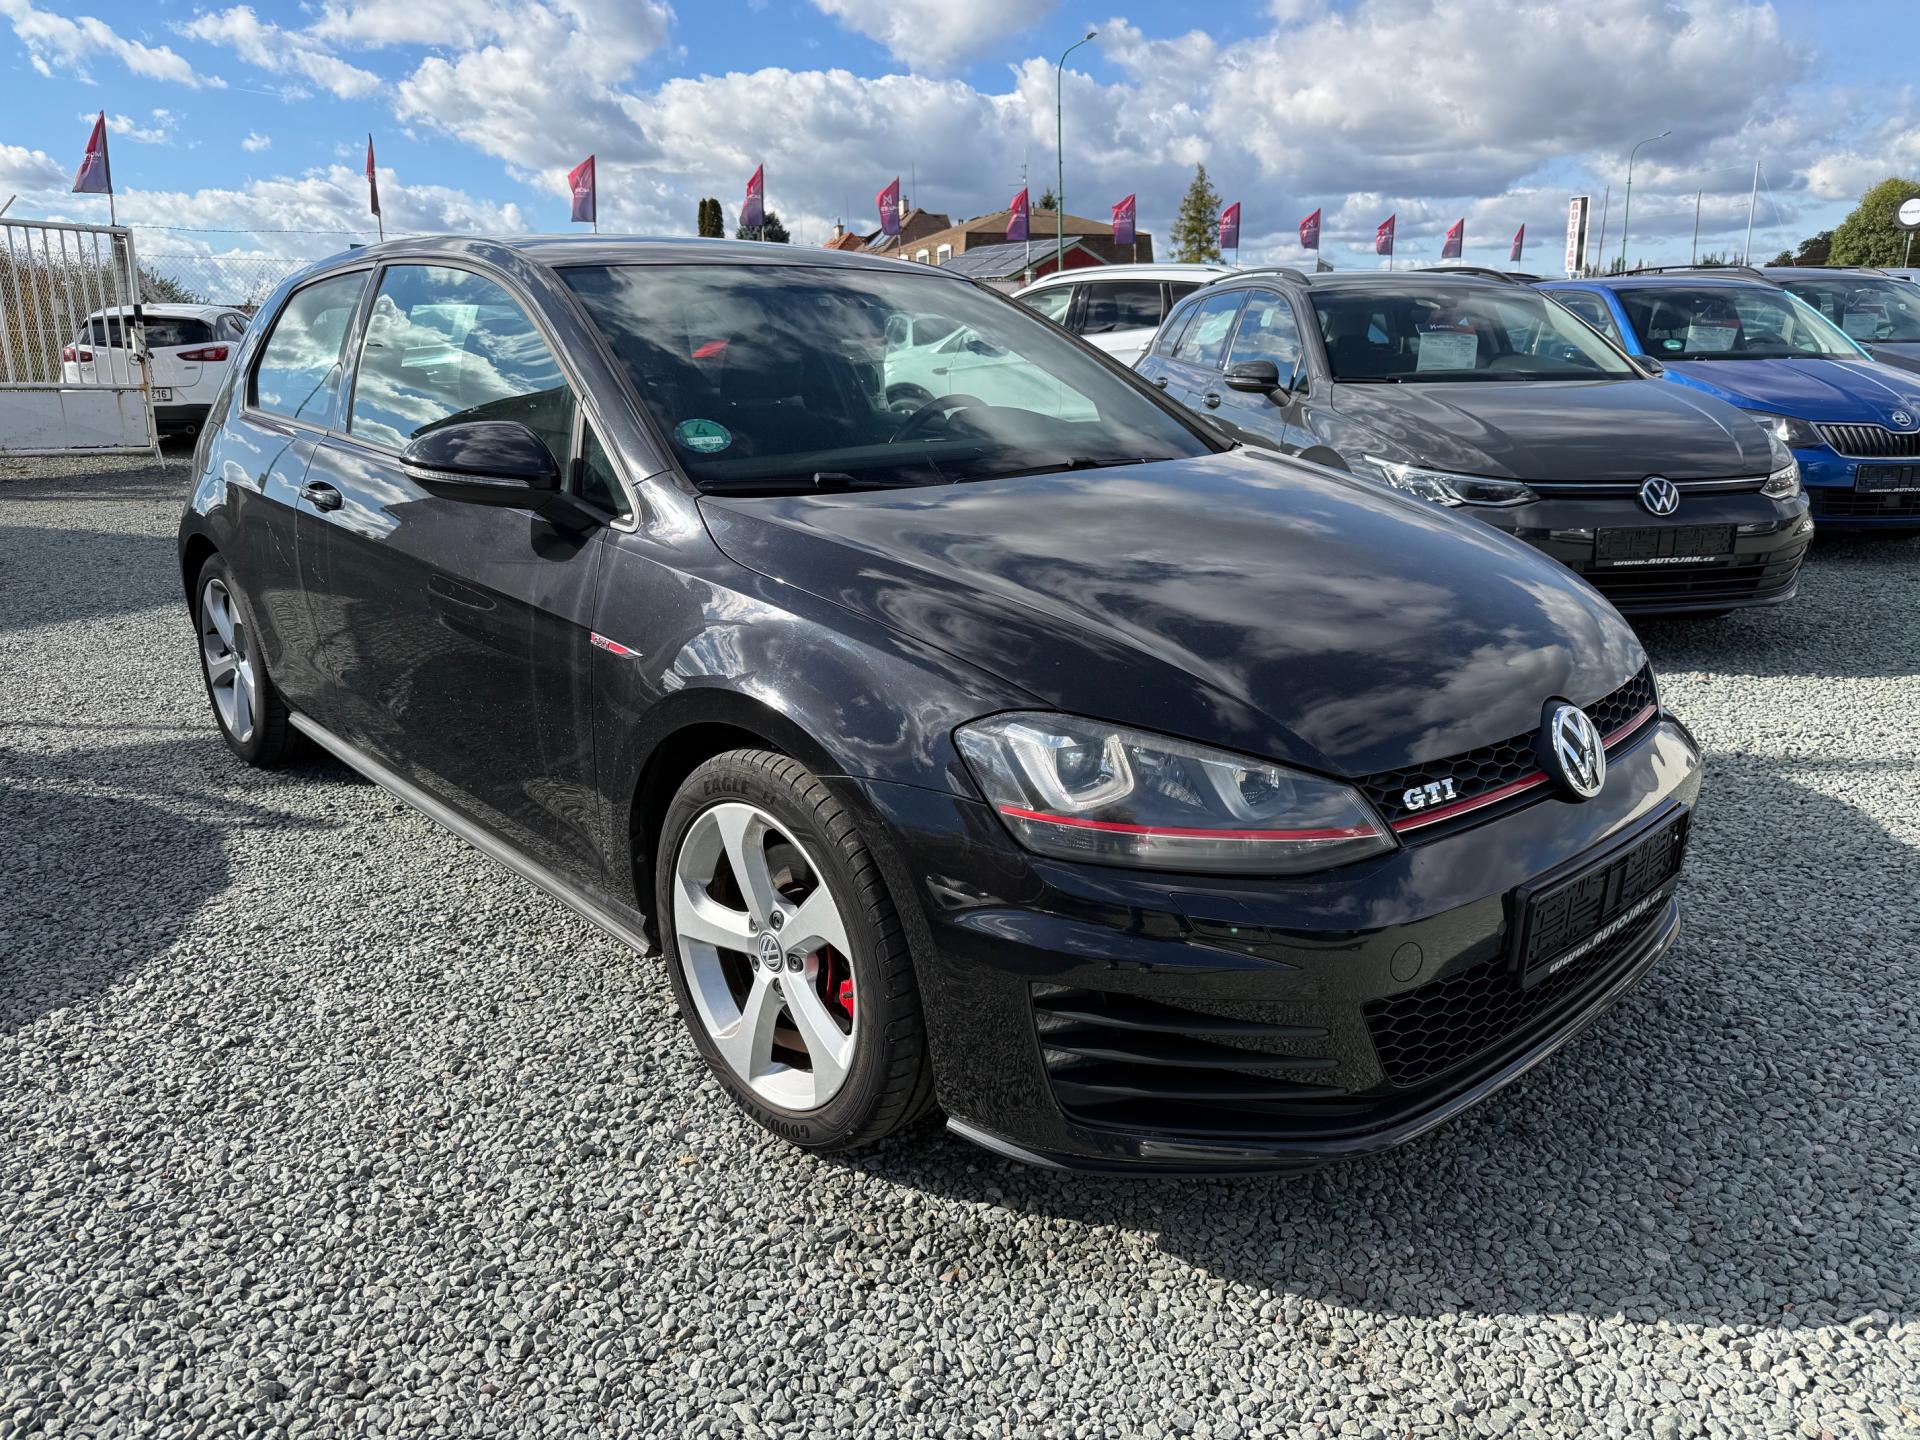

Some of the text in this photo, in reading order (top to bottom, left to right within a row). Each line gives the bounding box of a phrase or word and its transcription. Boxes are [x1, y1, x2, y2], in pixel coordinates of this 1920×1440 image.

[1567, 202, 1579, 268] AUTOJAN
[704, 777, 750, 796] EAGLE
[1403, 777, 1457, 810] GTI
